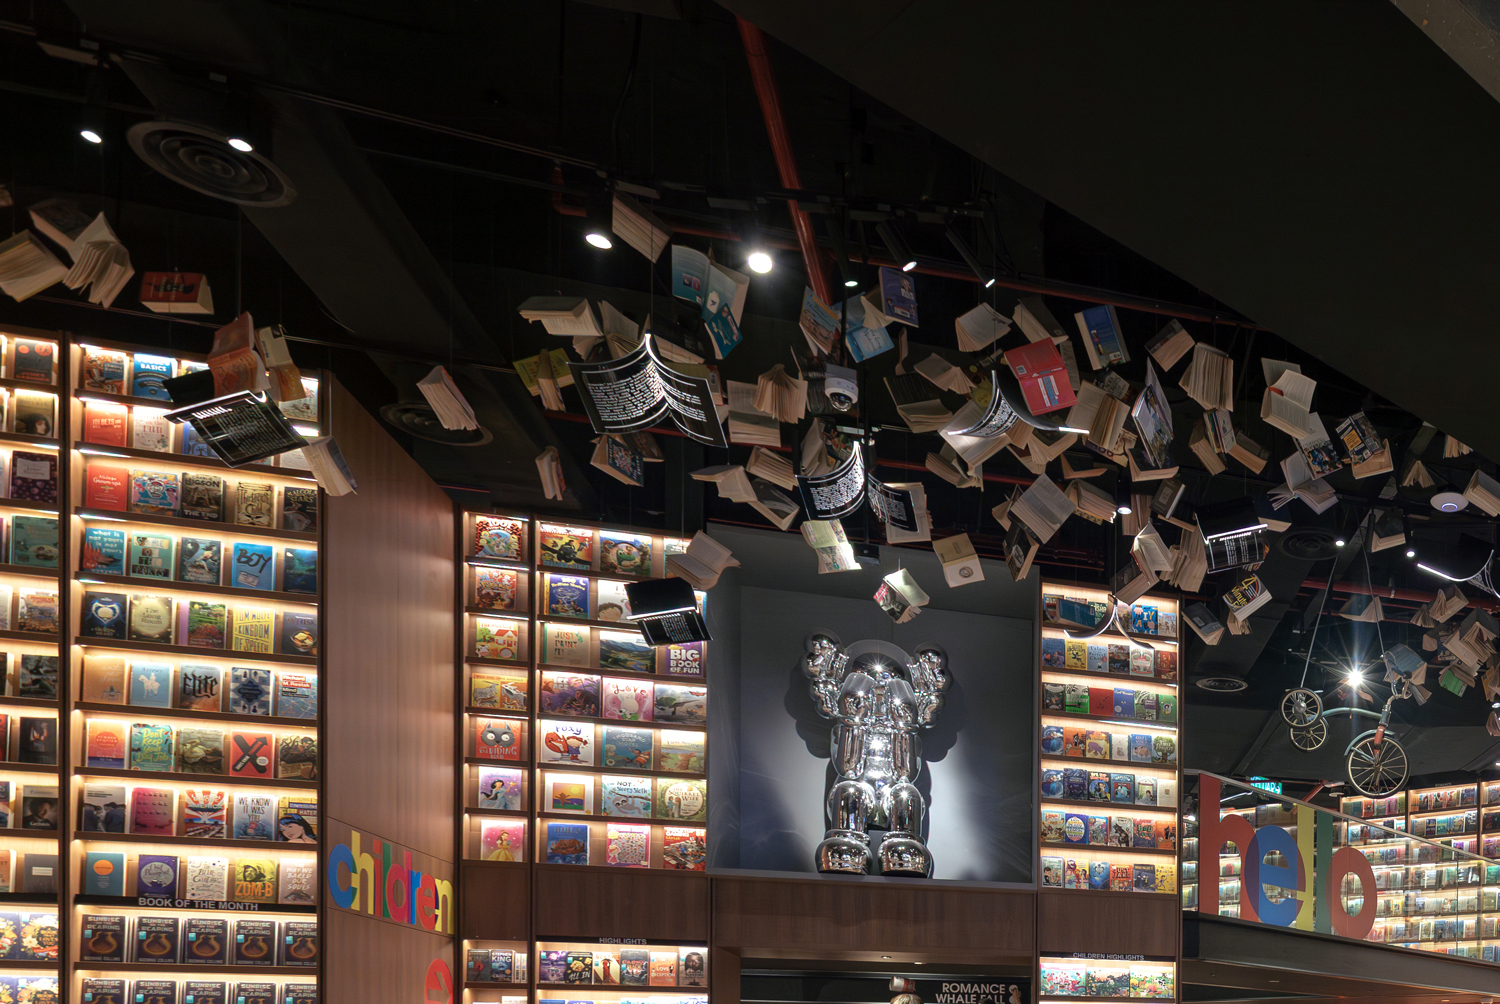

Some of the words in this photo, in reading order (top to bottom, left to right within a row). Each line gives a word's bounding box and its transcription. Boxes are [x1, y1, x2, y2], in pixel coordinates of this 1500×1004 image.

[237, 548, 272, 574] BOY
[670, 650, 699, 660] BIG
[328, 830, 454, 935] children
[236, 882, 273, 897] ZOM-B
[138, 897, 172, 907] BOOK
[175, 899, 191, 908] OF
[193, 900, 217, 909] THE
[219, 902, 258, 911] MONTH
[599, 937, 647, 945] HIGHLIGHTS
[943, 983, 1005, 993] ROMANCE
[935, 994, 976, 1004] WHALE
